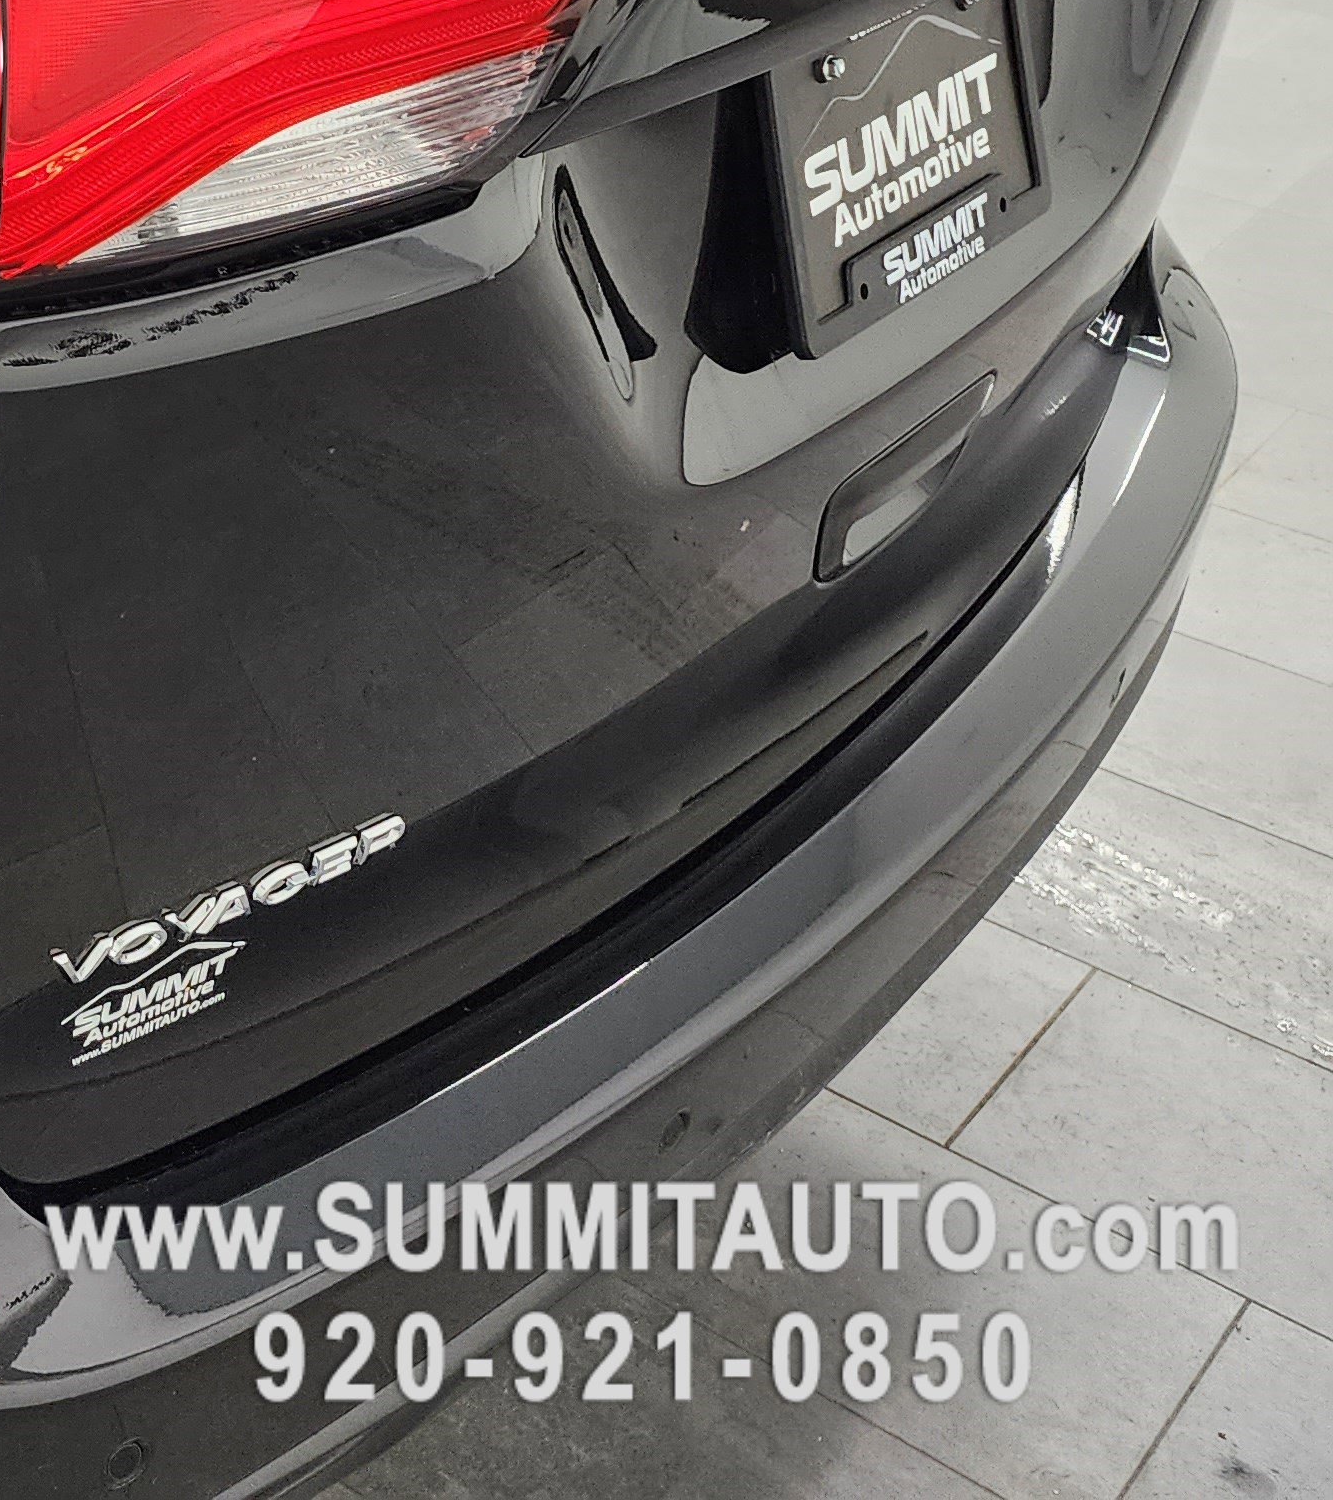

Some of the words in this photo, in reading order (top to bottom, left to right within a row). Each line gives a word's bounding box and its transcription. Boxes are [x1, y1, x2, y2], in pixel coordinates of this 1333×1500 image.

[804, 52, 998, 217] SUMMIT
[834, 127, 991, 248] Automotive
[882, 191, 988, 287] SUMMIT
[899, 235, 986, 304] Automotive
[50, 812, 406, 983] VOYAGER
[71, 991, 226, 1067] www.SUMMITAUTO.com
[72, 947, 240, 1038] SUMMIT
[82, 979, 215, 1048] Automotive
